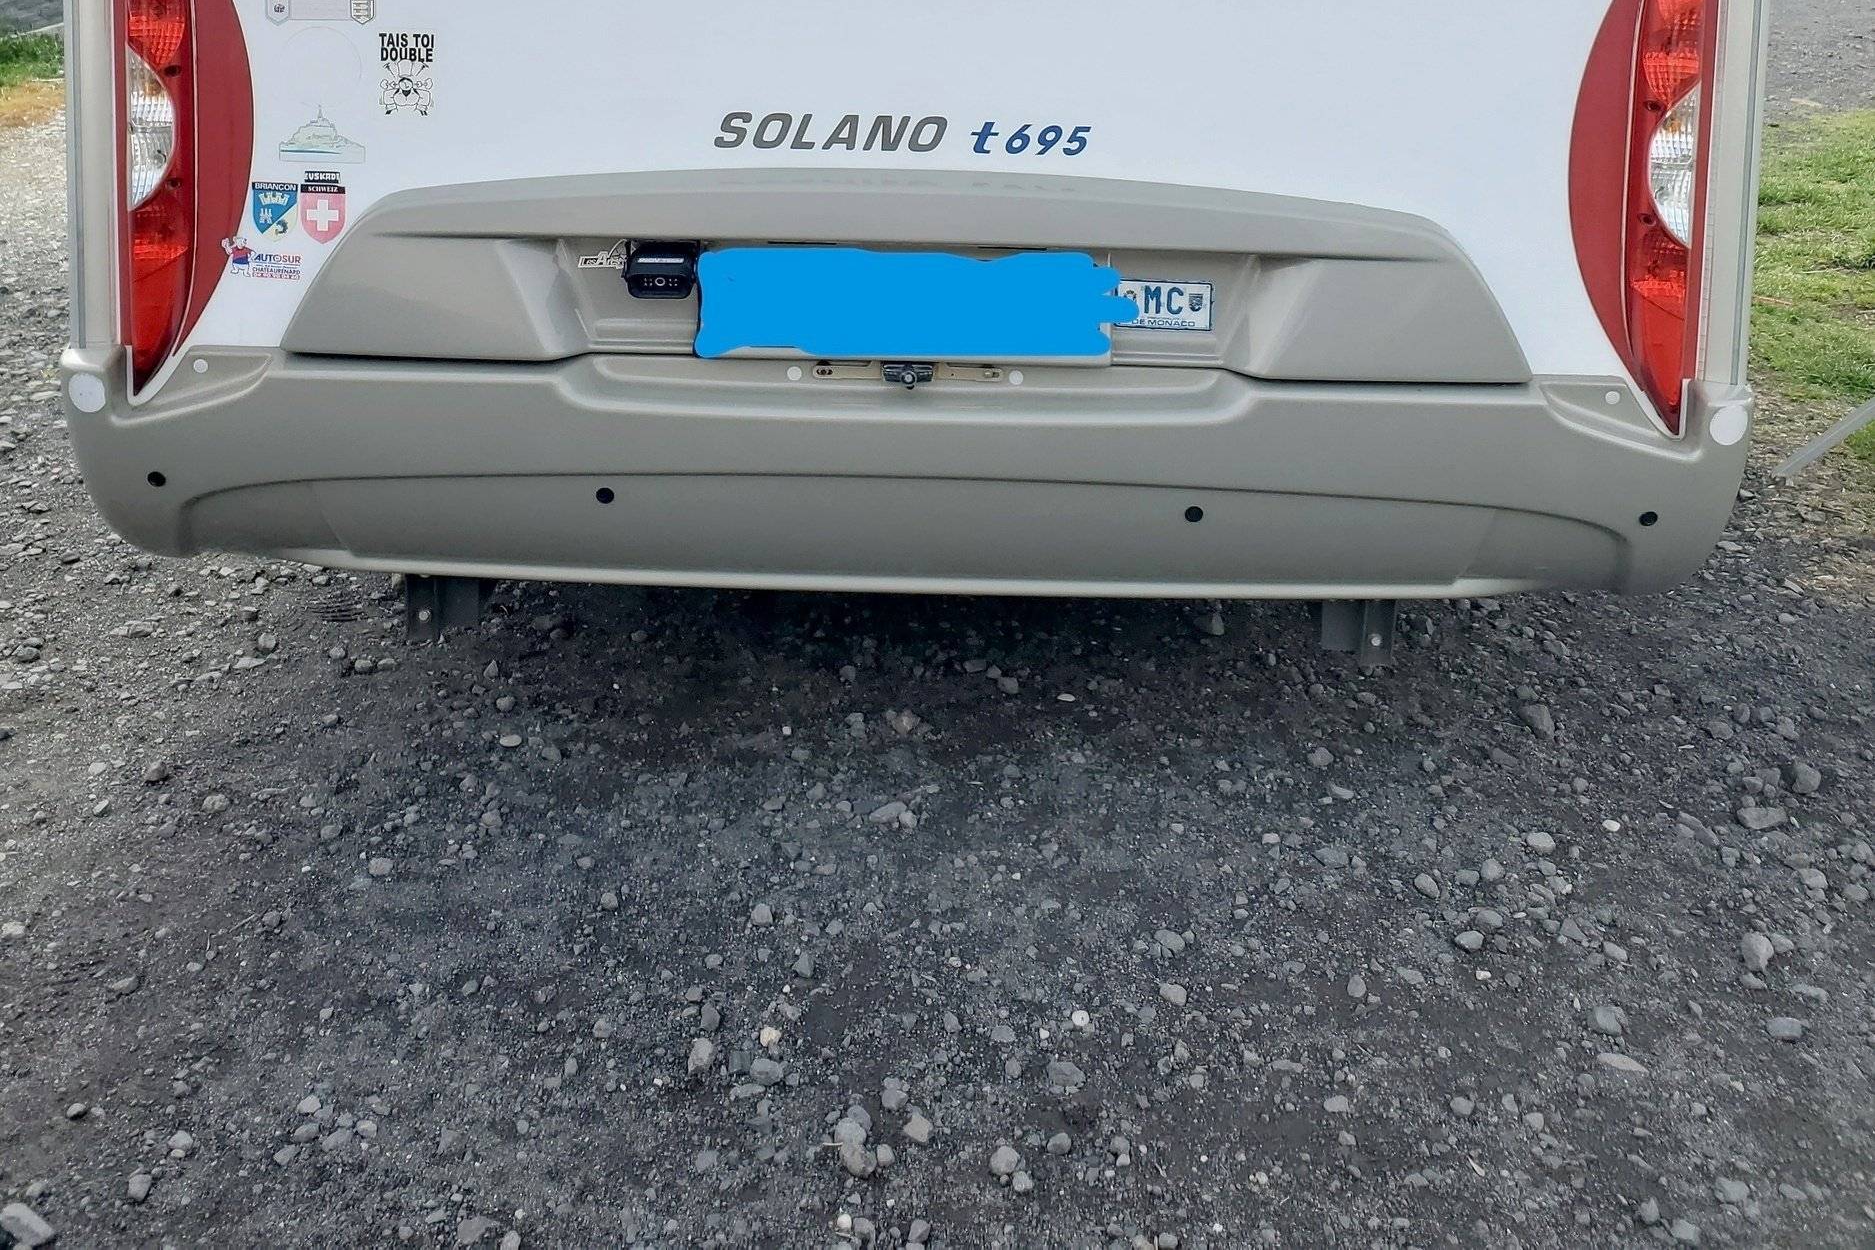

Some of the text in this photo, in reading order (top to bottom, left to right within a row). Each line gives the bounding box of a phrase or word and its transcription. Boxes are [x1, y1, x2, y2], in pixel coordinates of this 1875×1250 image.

[379, 33, 434, 49] TAIS TOI
[380, 48, 433, 62] DOUBLE
[714, 112, 948, 152] SOLANO
[253, 253, 301, 264] AUTOSUR
[1144, 285, 1184, 315] MC
[1147, 319, 1196, 327] MONACO
